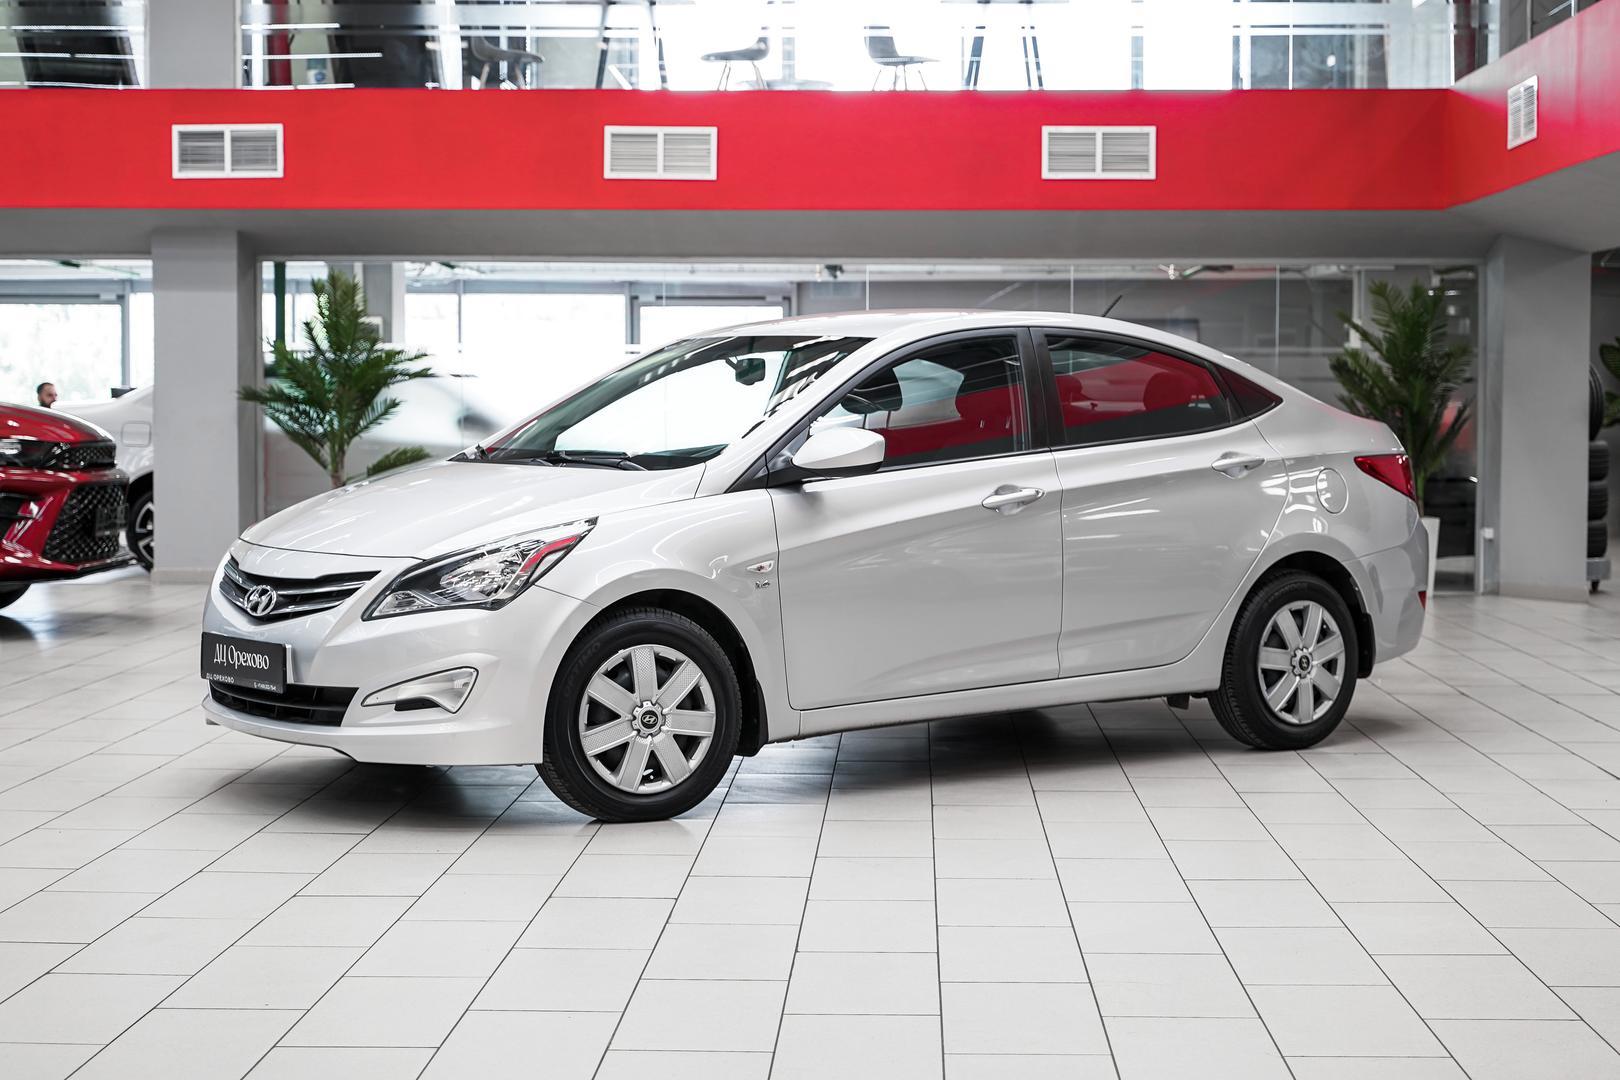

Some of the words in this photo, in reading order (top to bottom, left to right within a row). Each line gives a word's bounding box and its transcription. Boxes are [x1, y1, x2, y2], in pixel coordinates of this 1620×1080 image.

[213, 643, 227, 667] ДЦ
[228, 645, 270, 670] Орехово
[213, 673, 235, 684] ОРЕХОВО
